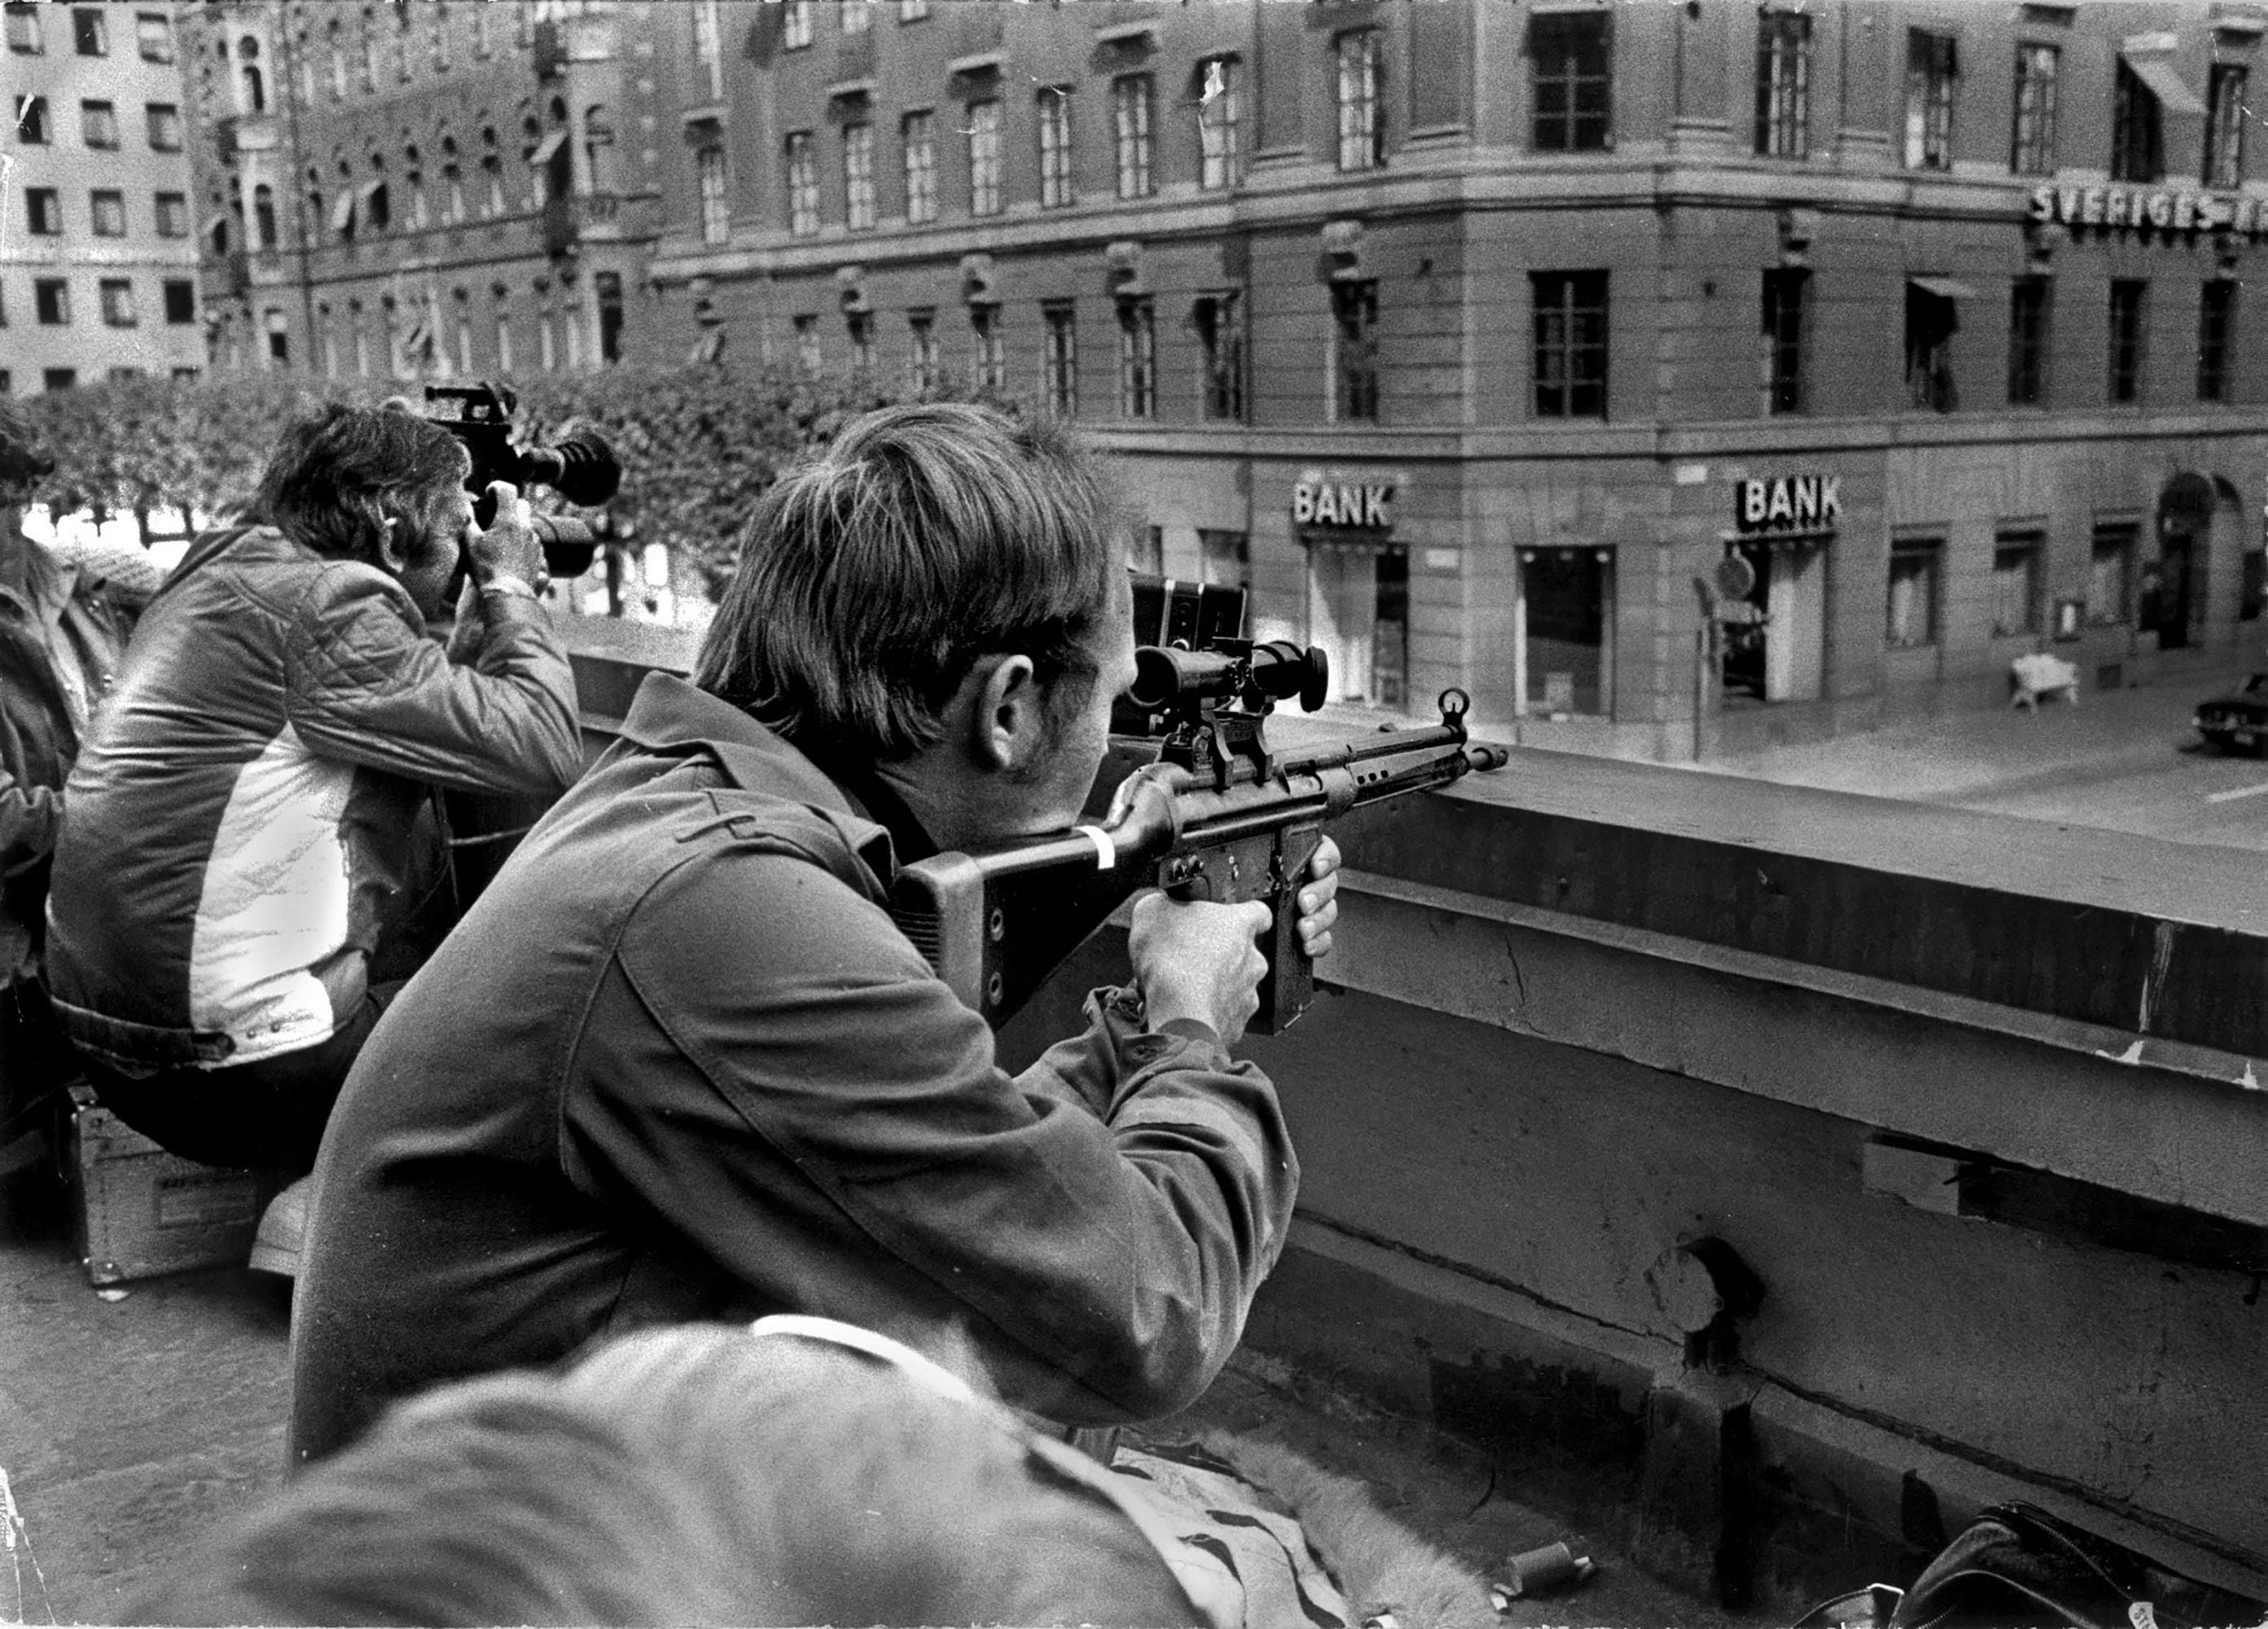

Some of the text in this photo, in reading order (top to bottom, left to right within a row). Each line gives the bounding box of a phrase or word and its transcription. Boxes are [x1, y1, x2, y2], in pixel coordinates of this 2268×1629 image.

[2033, 186, 2213, 230] SVERIGES
[1294, 483, 1390, 526] BANK
[1745, 476, 1843, 523] BANK
